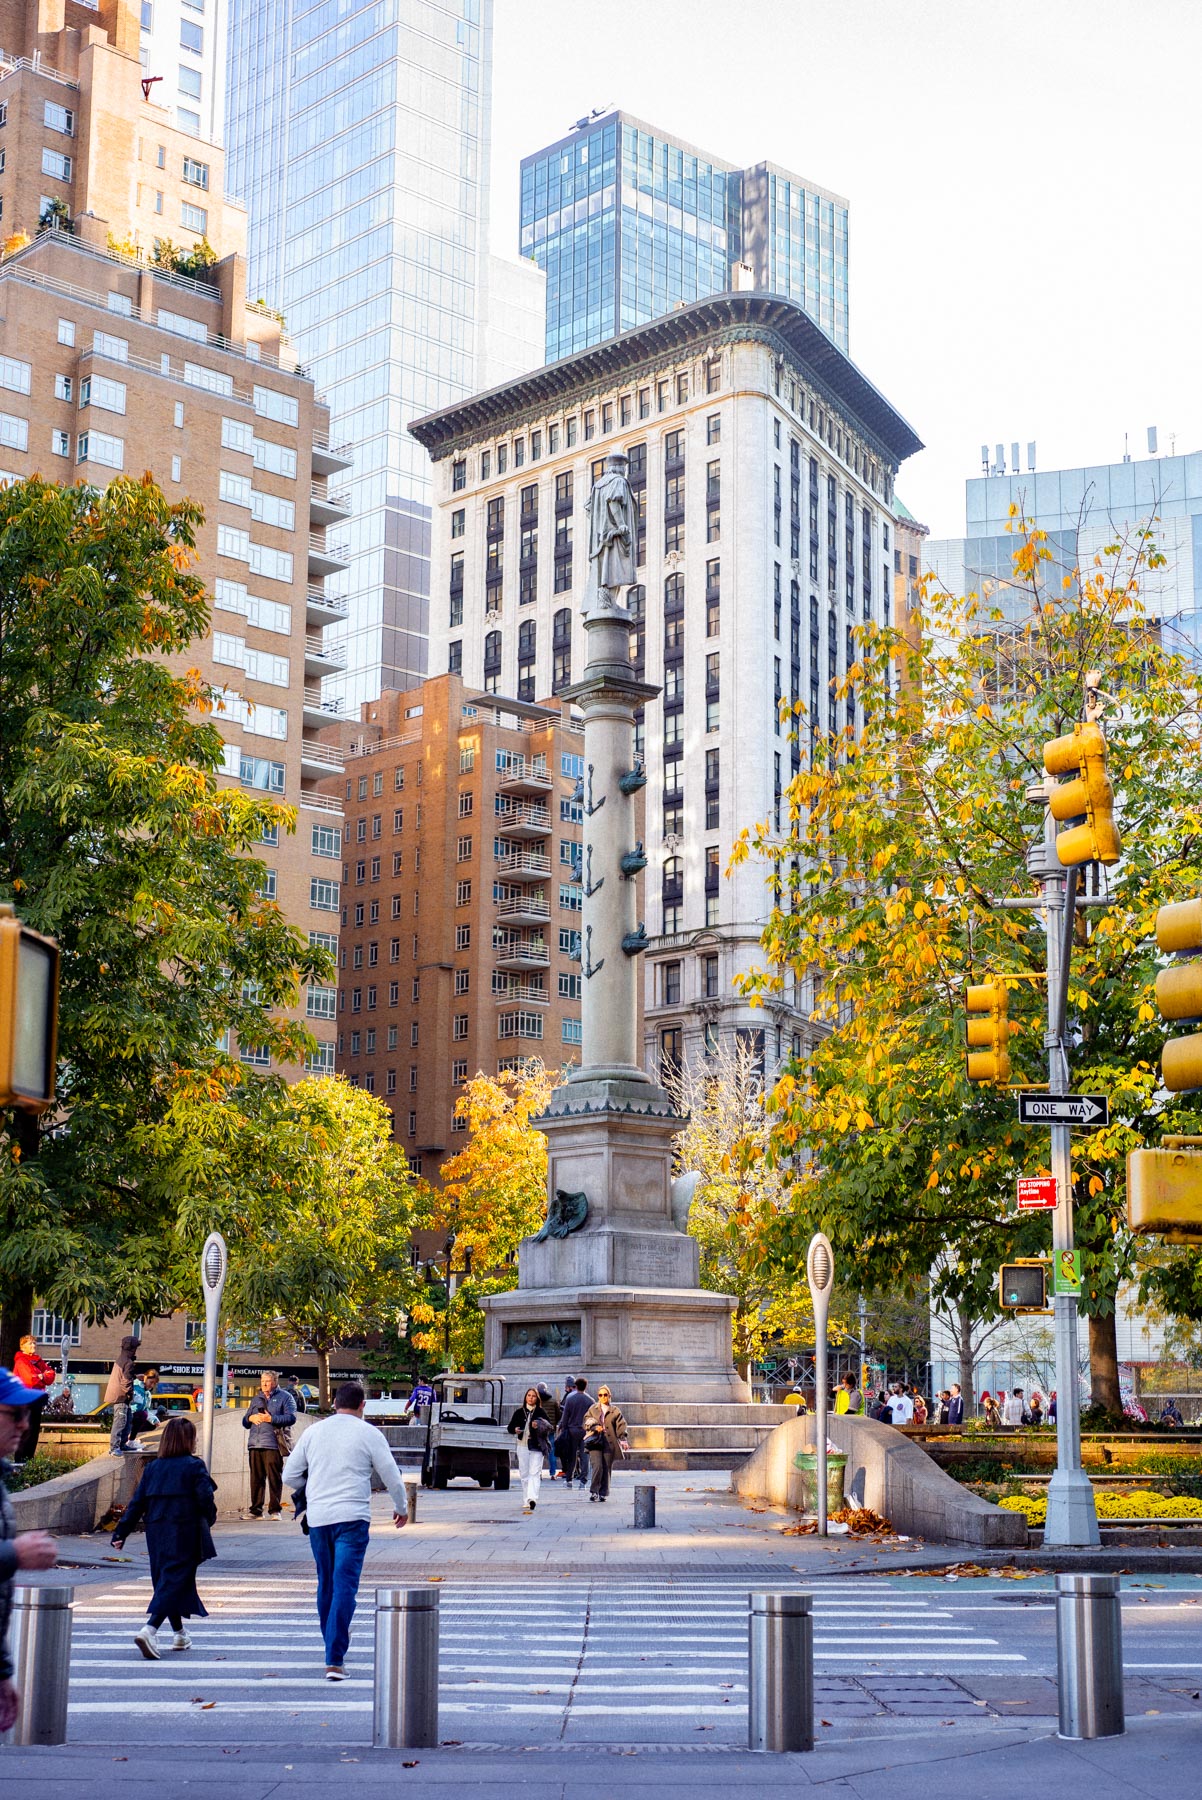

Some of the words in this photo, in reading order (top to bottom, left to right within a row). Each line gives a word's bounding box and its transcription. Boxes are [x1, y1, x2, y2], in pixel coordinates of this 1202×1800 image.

[1032, 1103, 1057, 1115] ONE
[1068, 1104, 1094, 1116] WAY
[1027, 1180, 1050, 1188] STOPPING
[1020, 1188, 1040, 1196] Anytime
[172, 1365, 190, 1374] SHOE
[191, 1366, 205, 1374] REP
[416, 1394, 430, 1407] 23
